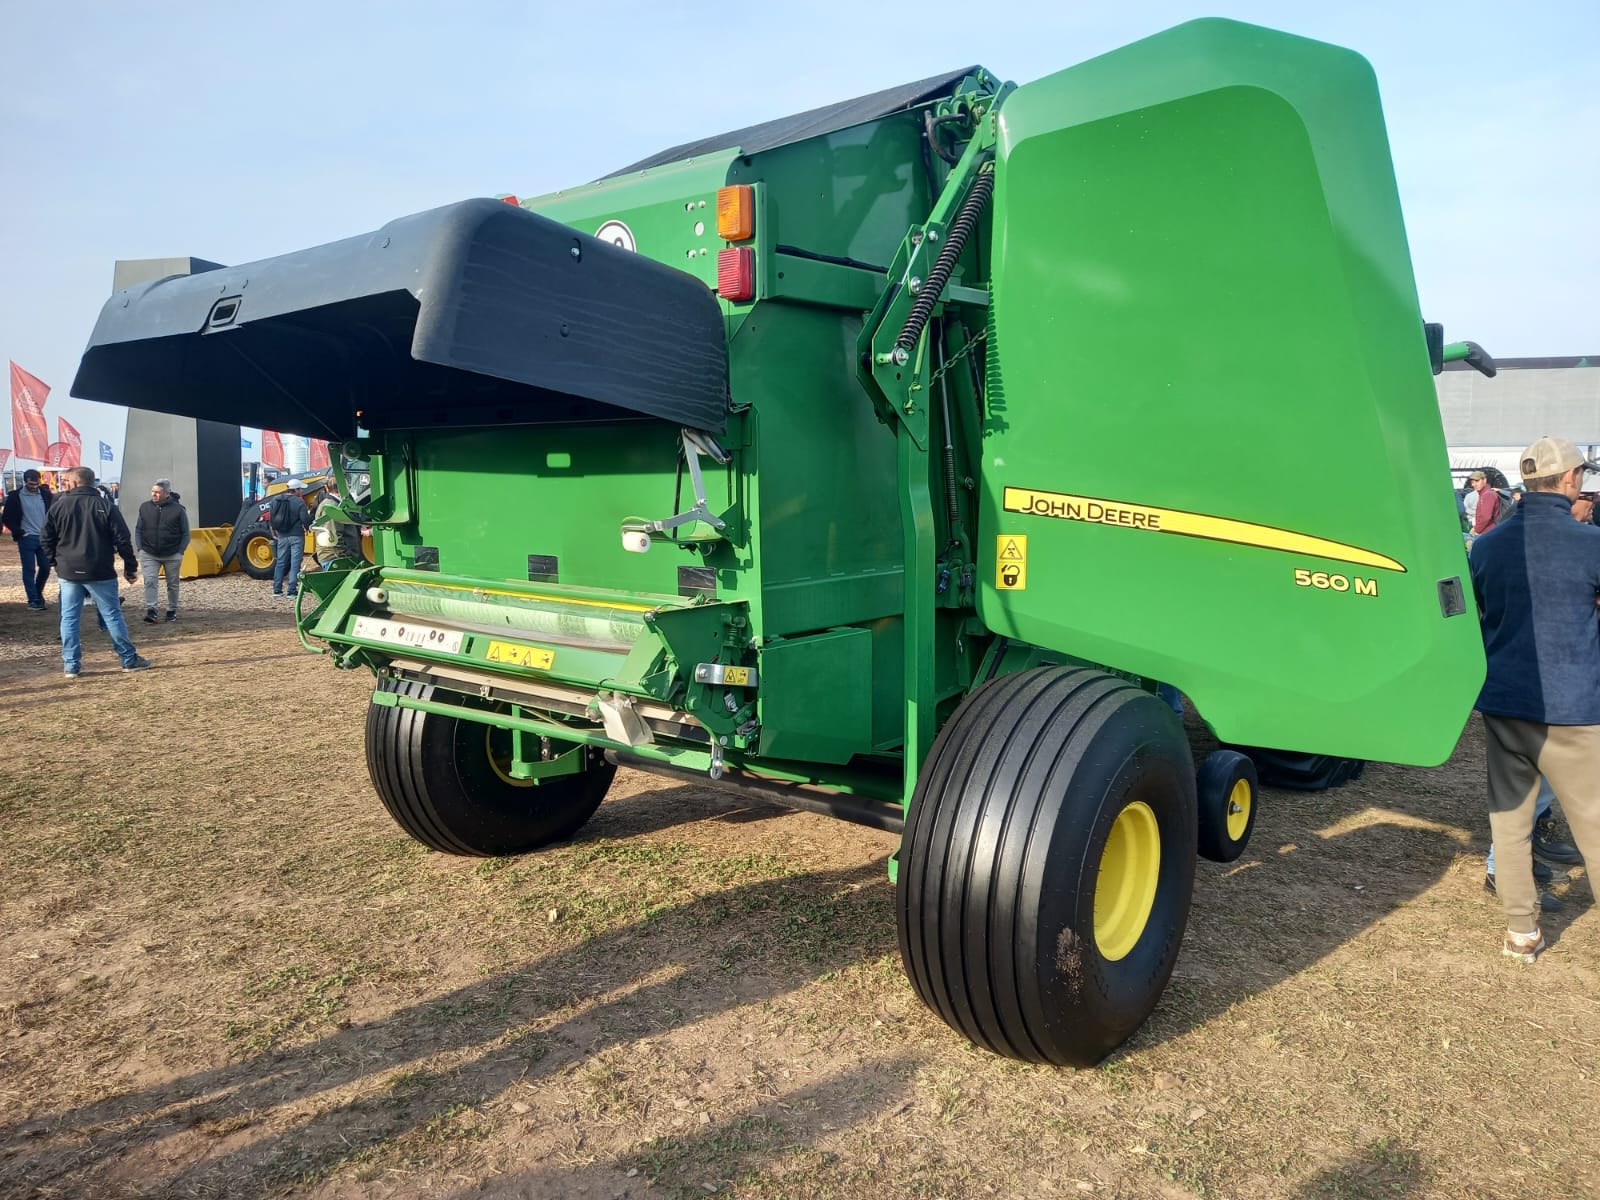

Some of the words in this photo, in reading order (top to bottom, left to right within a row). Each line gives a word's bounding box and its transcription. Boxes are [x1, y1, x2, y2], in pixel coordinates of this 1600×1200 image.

[1022, 495, 1081, 518] JOHN
[1087, 502, 1161, 529] DEERE
[1294, 568, 1350, 592] 560
[1354, 576, 1378, 597] M
